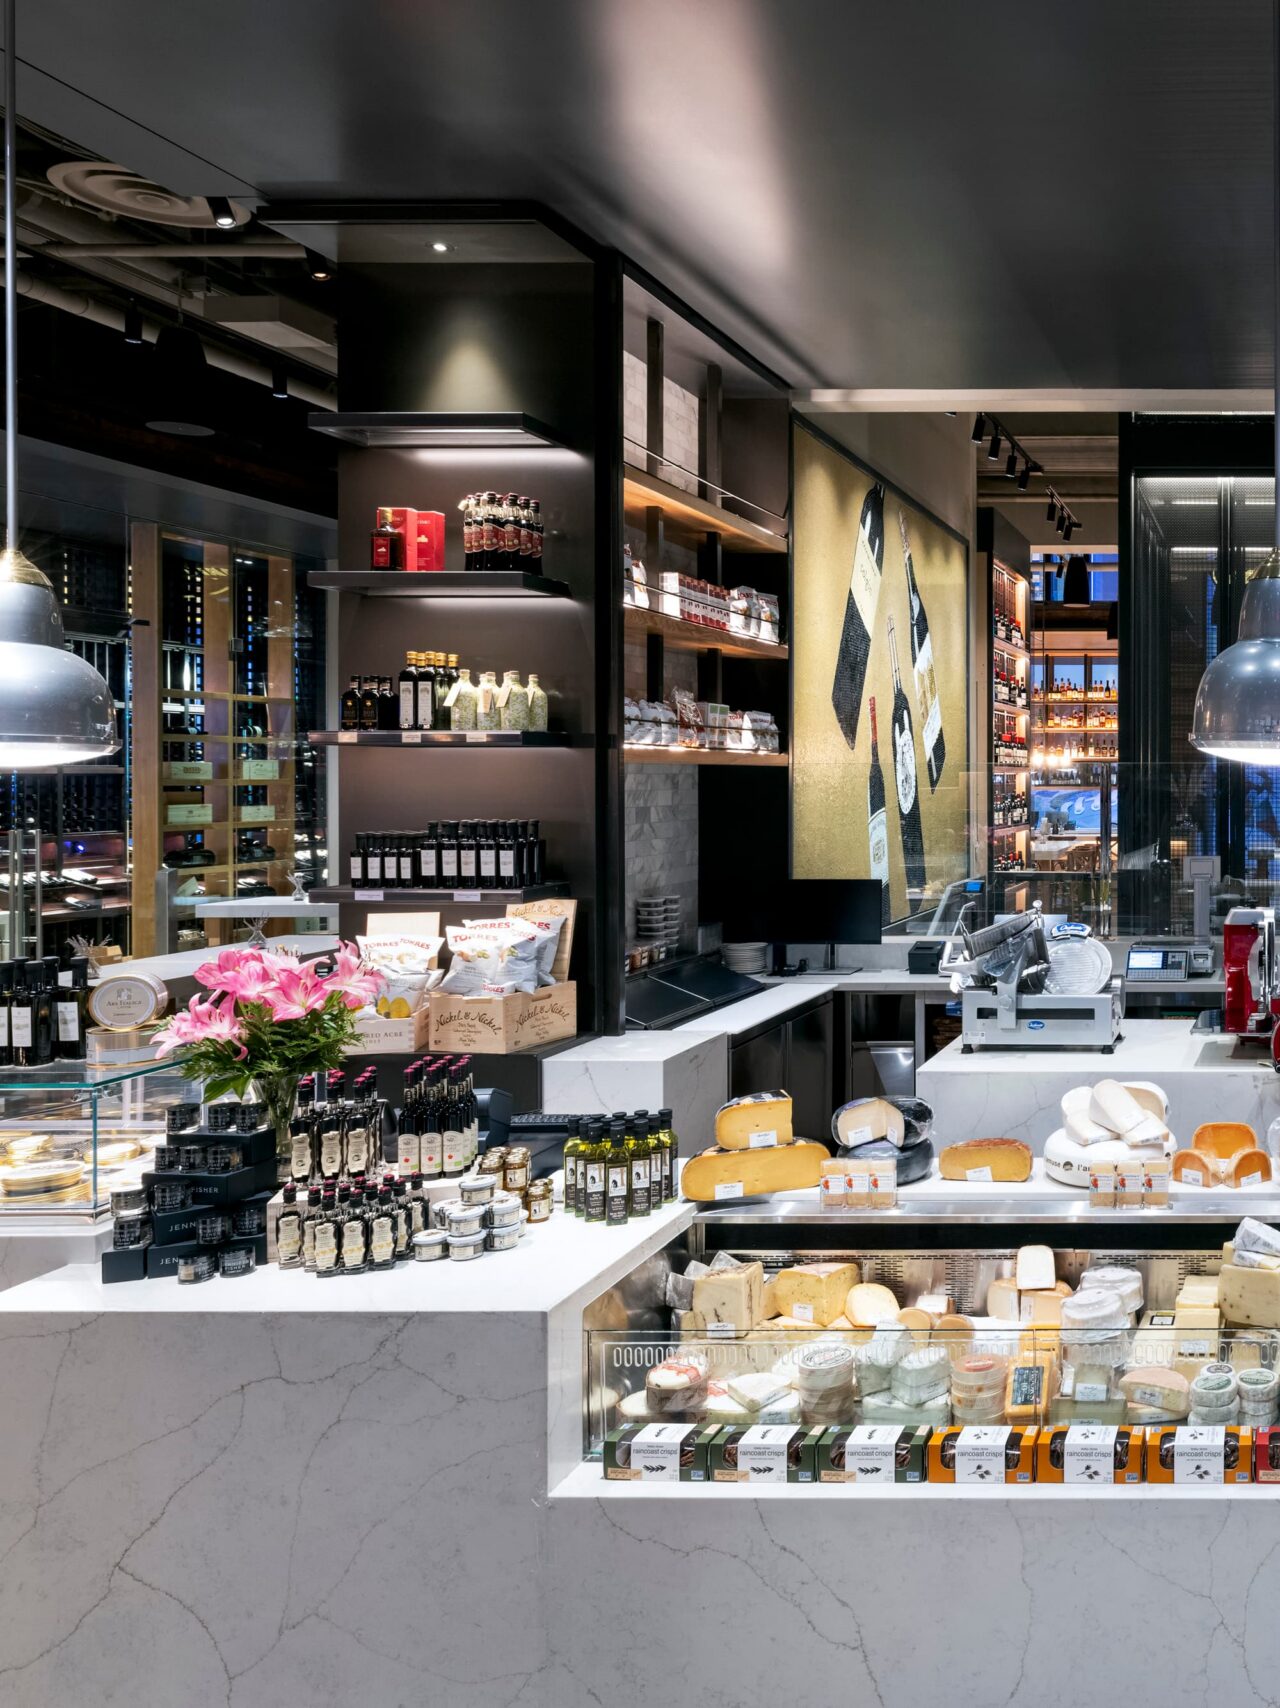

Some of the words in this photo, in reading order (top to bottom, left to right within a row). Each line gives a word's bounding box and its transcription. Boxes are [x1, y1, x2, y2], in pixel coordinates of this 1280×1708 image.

[363, 941, 400, 950] TORRES
[434, 1010, 462, 1032] Nickel
[471, 1011, 503, 1035] Nickel
[515, 1005, 540, 1033] Nickel
[540, 1005, 545, 1014] &
[545, 1002, 570, 1021] Nickel
[169, 1221, 196, 1232] JENN
[876, 1450, 894, 1458] crisps
